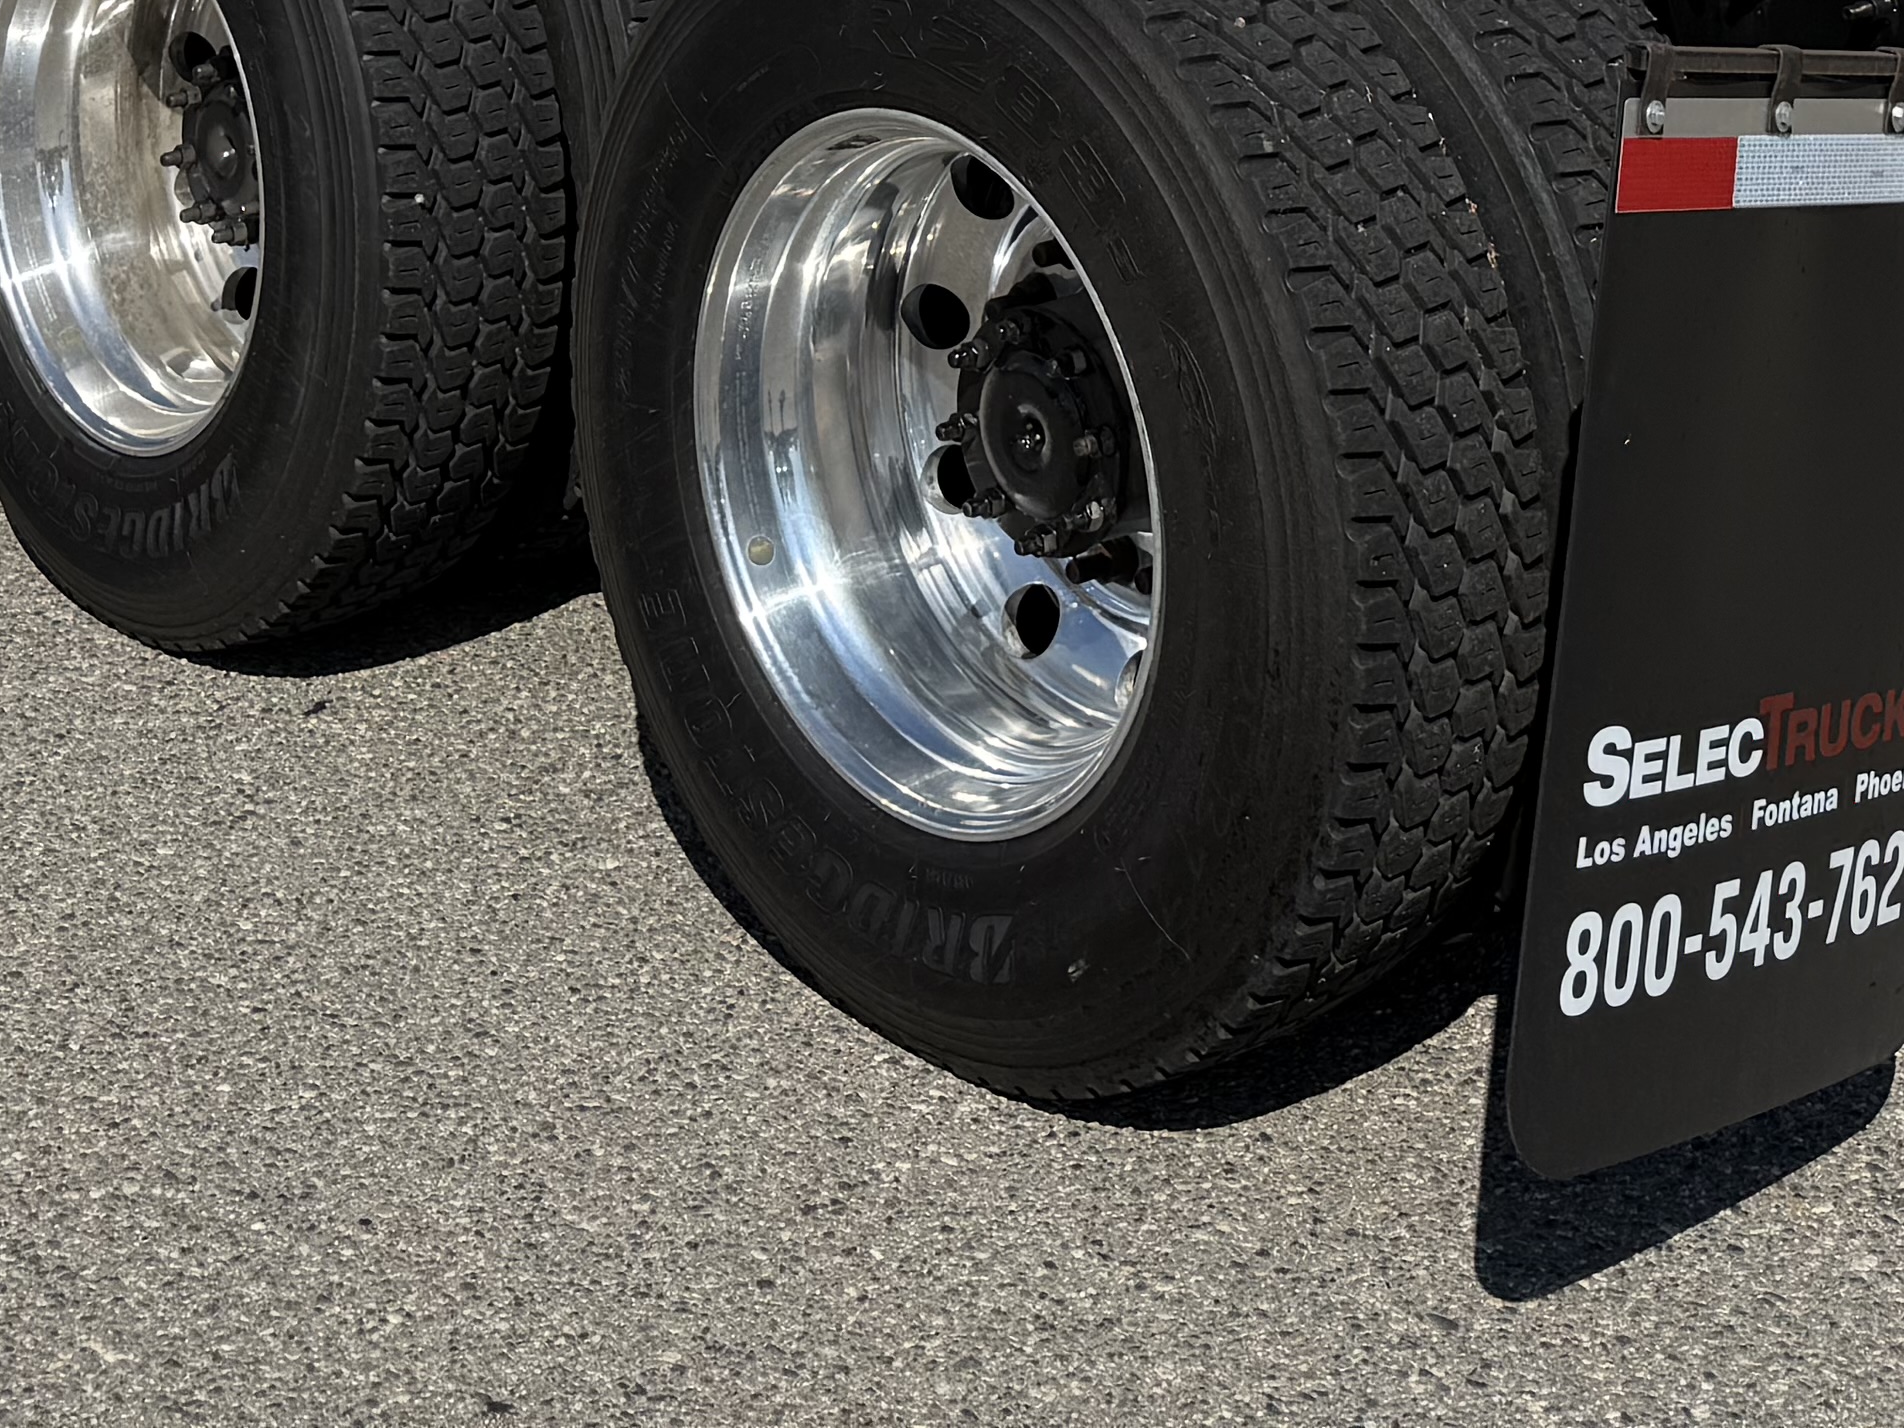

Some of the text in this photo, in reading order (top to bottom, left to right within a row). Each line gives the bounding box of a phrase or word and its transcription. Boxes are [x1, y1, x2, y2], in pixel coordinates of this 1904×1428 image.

[1575, 836, 1626, 869] Los
[1633, 811, 1733, 859] Angeles
[1751, 787, 1838, 831] Fontana
